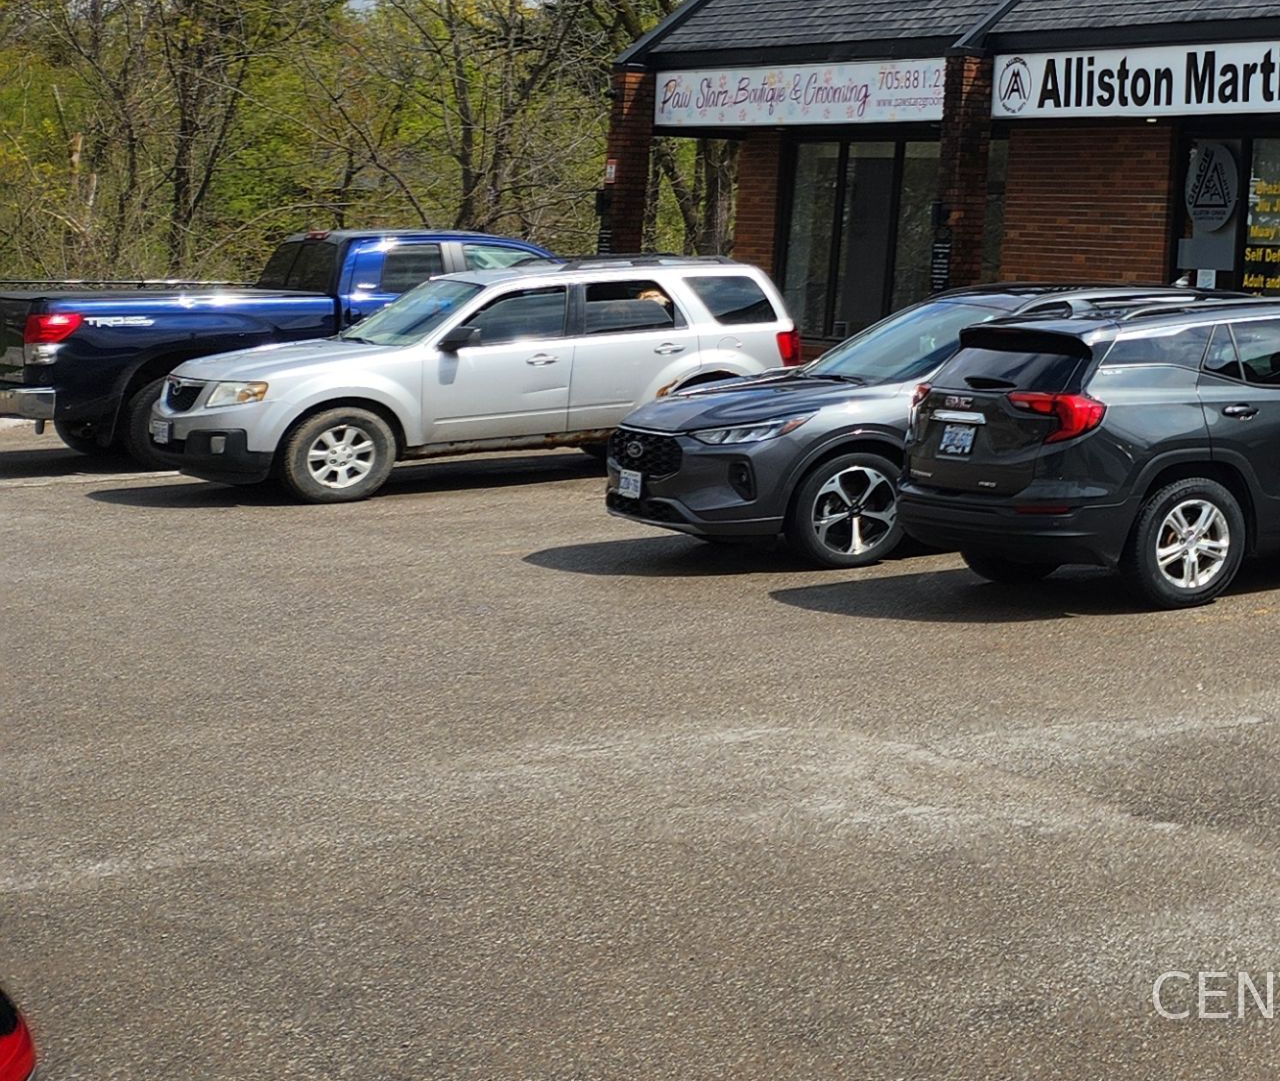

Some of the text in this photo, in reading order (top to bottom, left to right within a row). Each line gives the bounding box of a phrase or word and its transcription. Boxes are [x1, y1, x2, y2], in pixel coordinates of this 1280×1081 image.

[1037, 55, 1174, 109] Alliston
[660, 72, 872, 117] Paw Starz Boutique & Grooming
[1255, 199, 1271, 212] Jiu
[1250, 225, 1277, 240] Muay
[1244, 247, 1263, 261] Self
[1243, 273, 1265, 288] Adult
[1265, 275, 1280, 289] and
